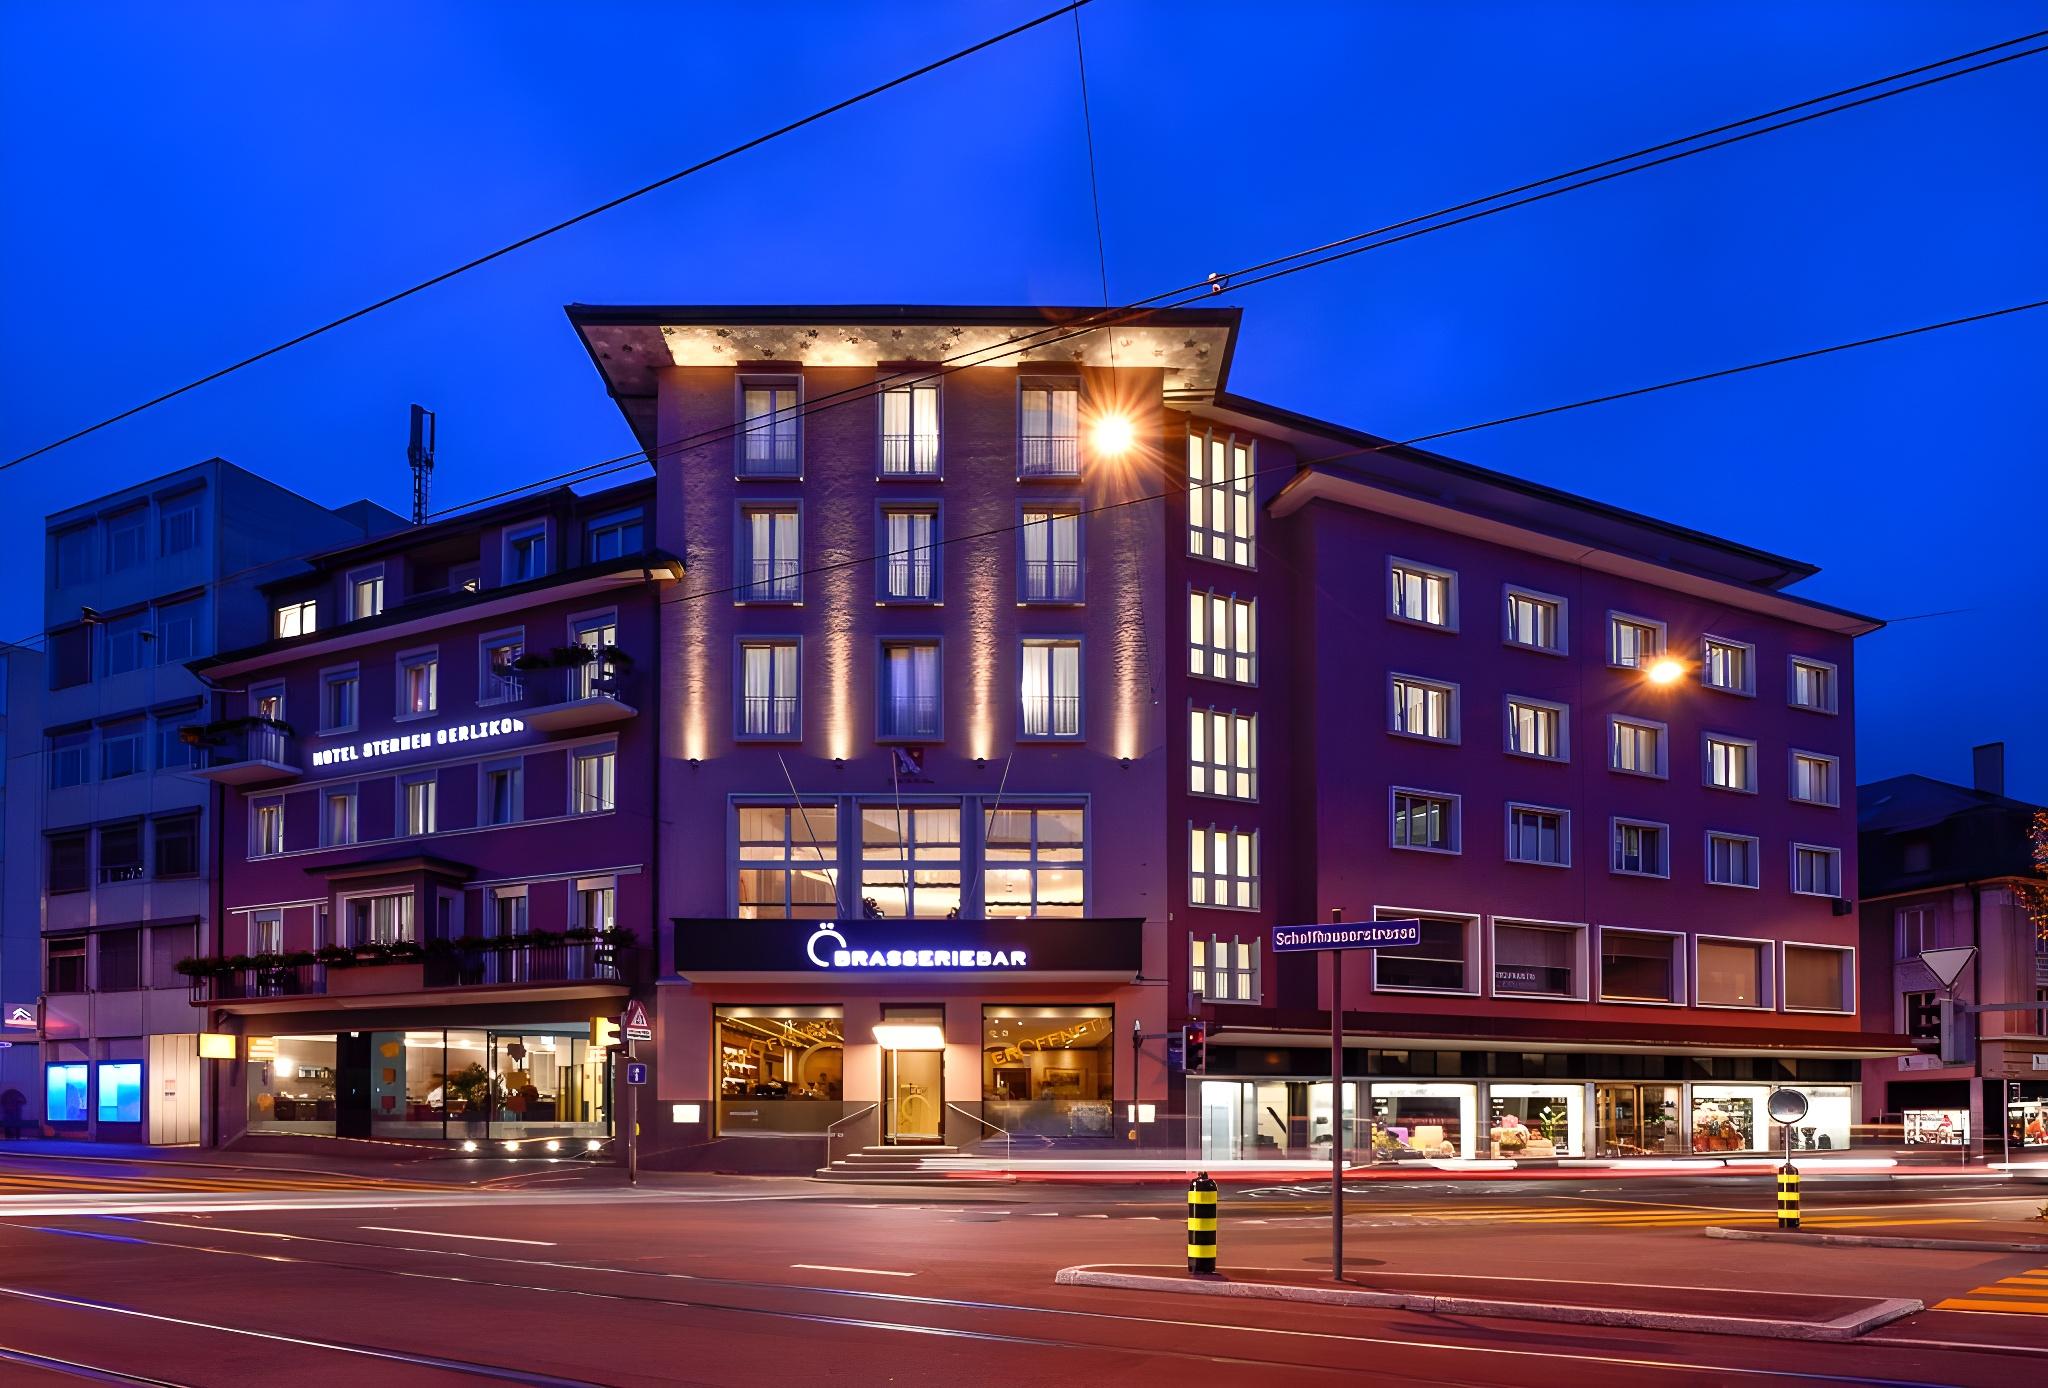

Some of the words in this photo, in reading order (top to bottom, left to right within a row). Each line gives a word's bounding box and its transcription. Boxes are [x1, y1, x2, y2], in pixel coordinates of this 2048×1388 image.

[312, 746, 358, 766] HOTEL
[363, 733, 431, 758] STERNEN
[437, 718, 524, 745] OERLIKON
[834, 950, 1027, 967] BRASSERIEBAR
